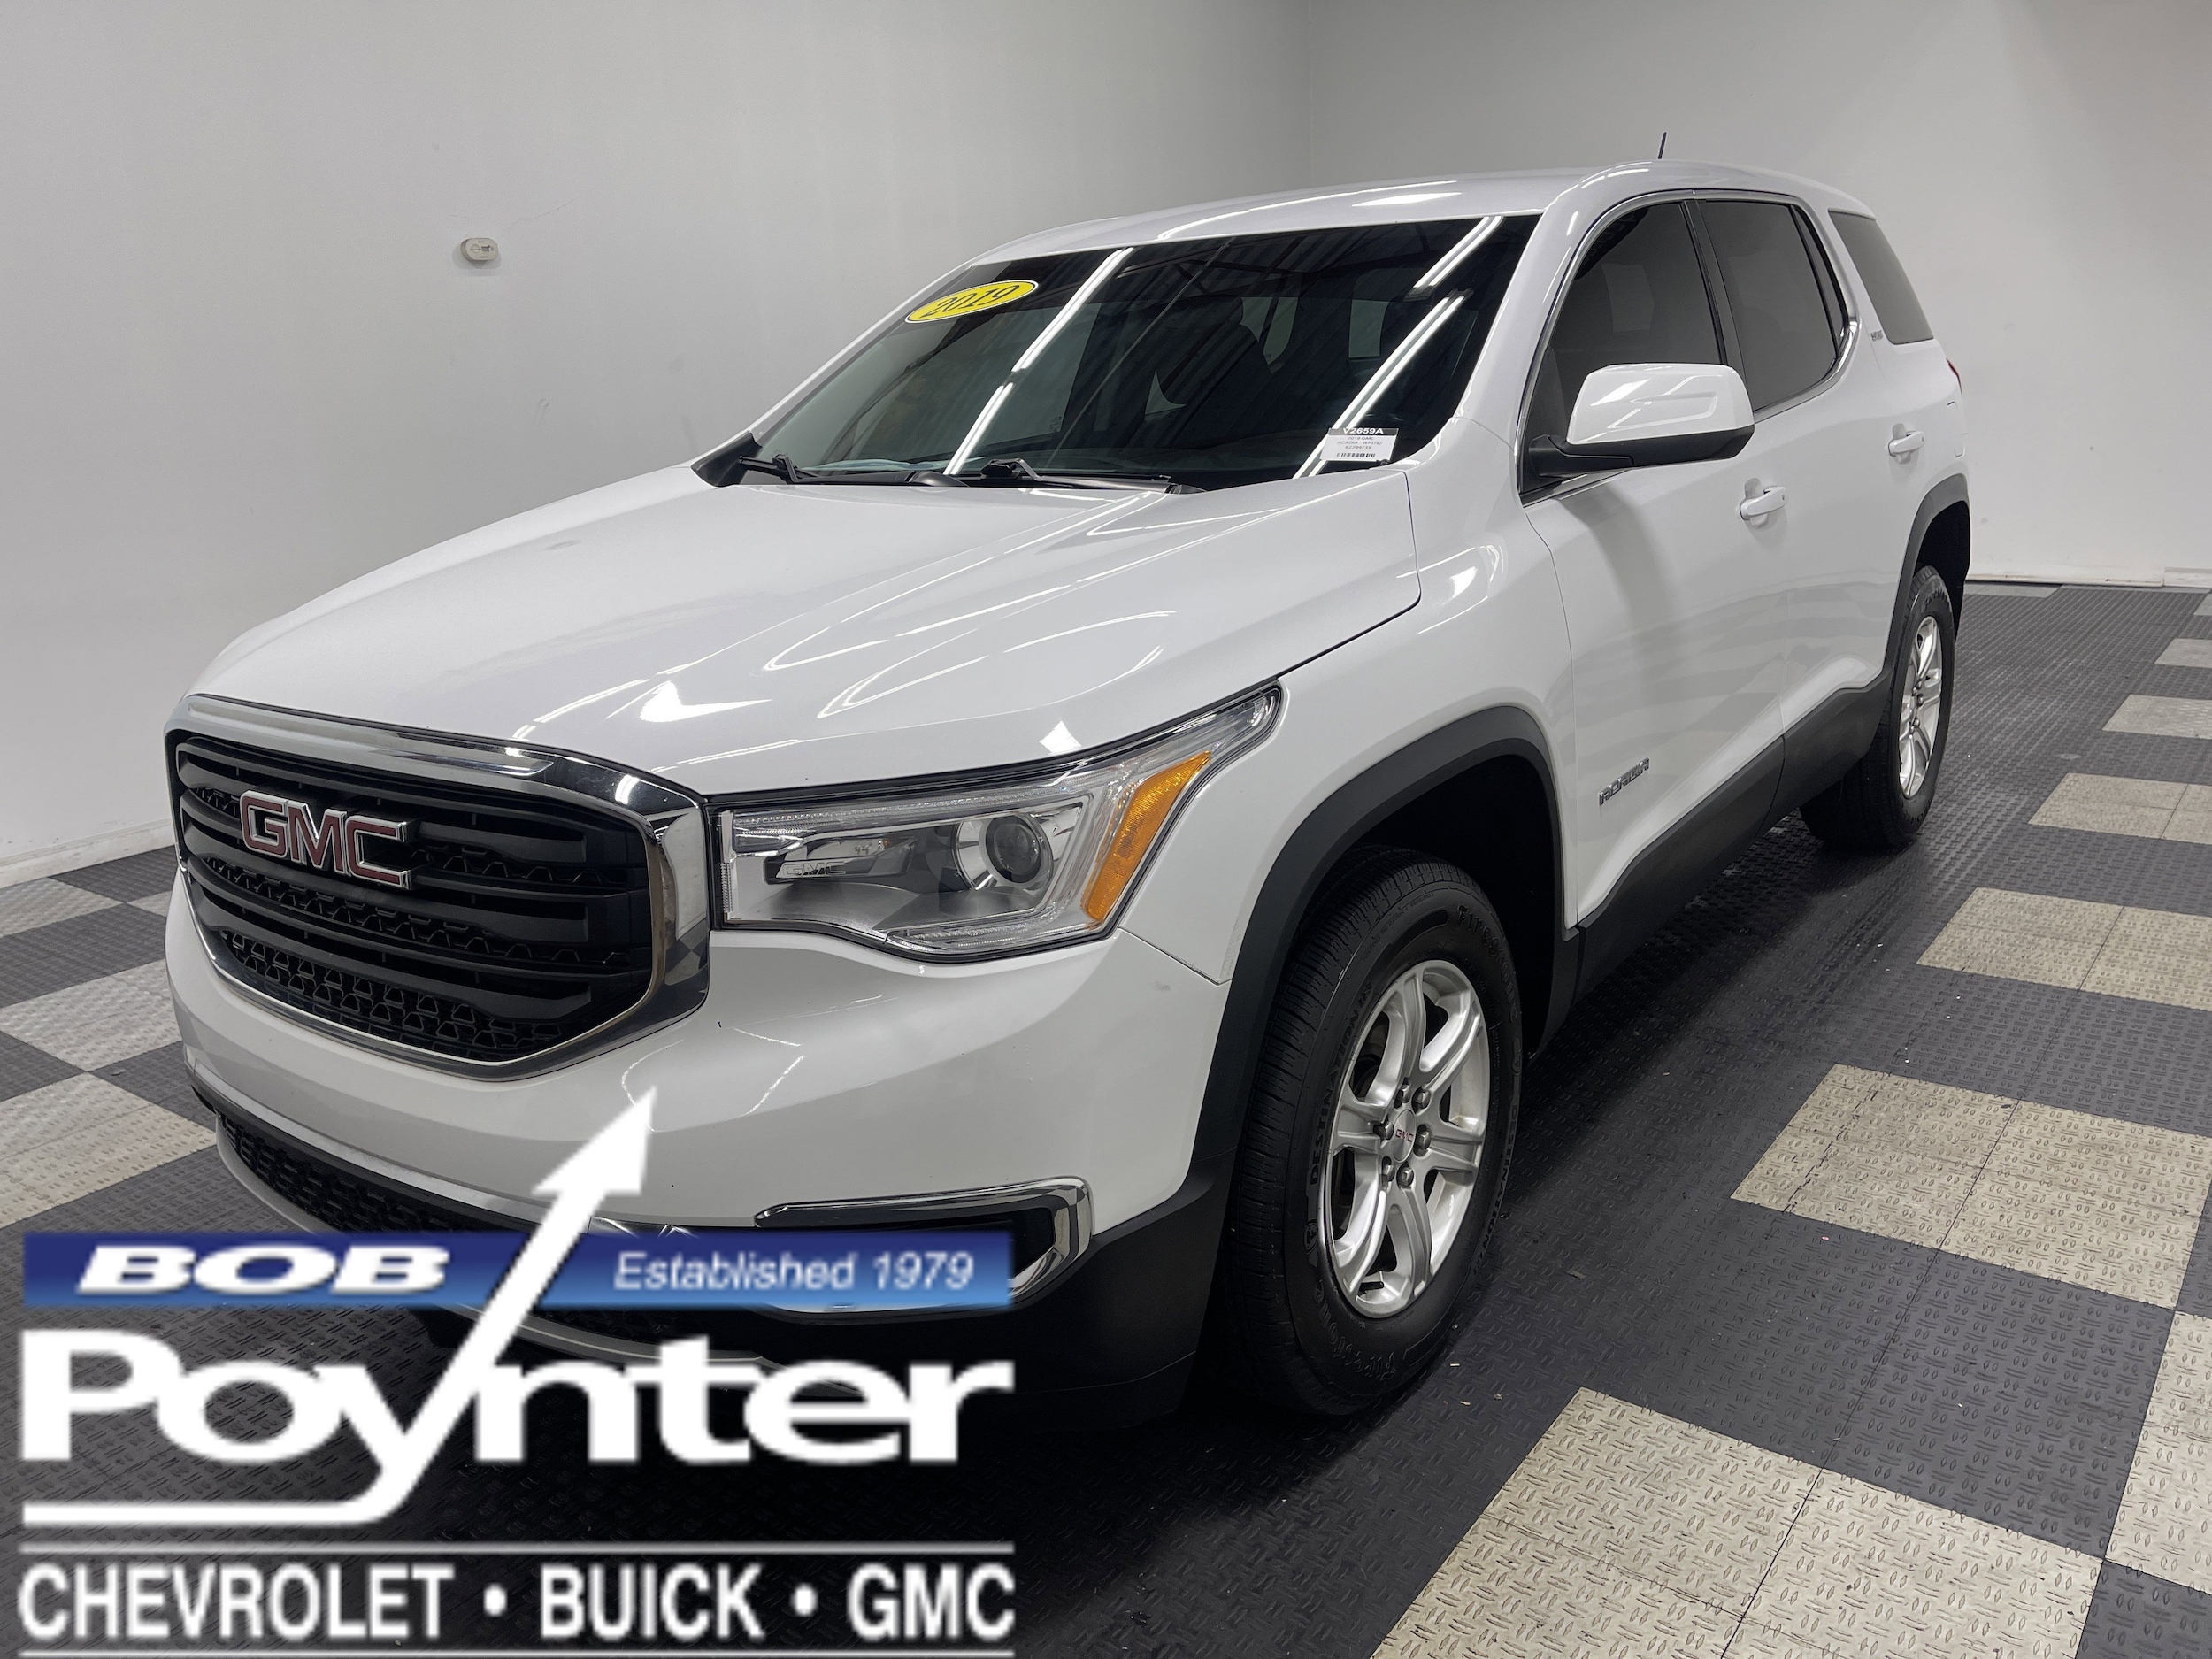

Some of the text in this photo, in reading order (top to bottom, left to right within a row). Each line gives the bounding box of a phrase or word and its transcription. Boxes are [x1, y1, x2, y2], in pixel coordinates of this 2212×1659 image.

[919, 284, 1020, 319] 2019
[240, 790, 411, 890] GMC
[782, 860, 846, 876] GMC
[1395, 1128, 1414, 1142] GMC
